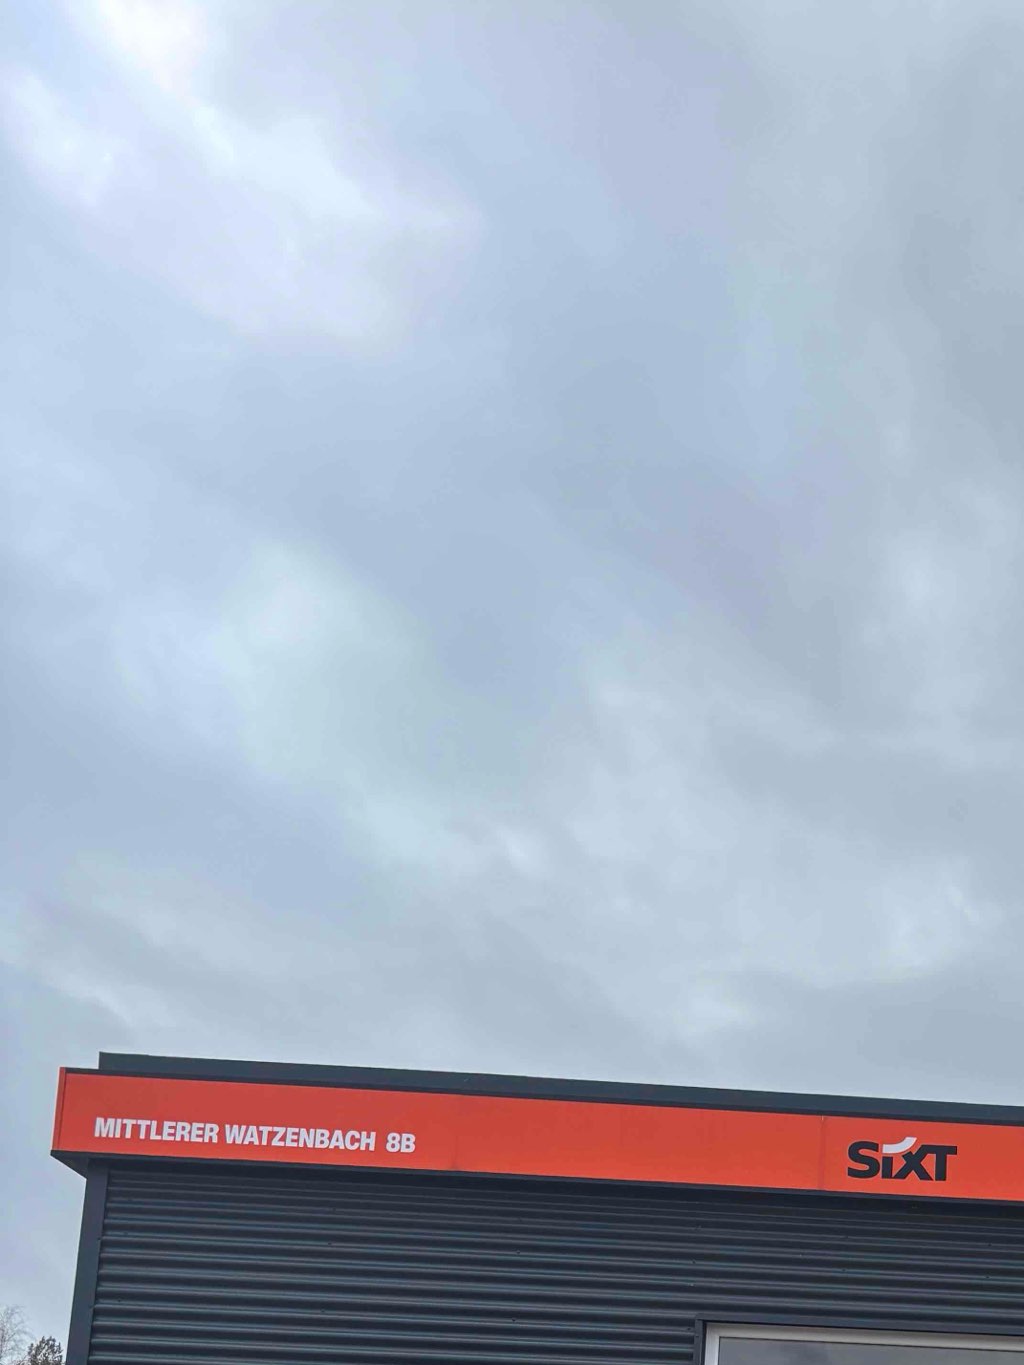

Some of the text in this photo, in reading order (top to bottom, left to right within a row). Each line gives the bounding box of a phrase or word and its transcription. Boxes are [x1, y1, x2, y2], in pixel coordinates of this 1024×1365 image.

[94, 1117, 416, 1153] MITTLERER WATZENBACH 8B
[847, 1136, 958, 1182] SIXT
